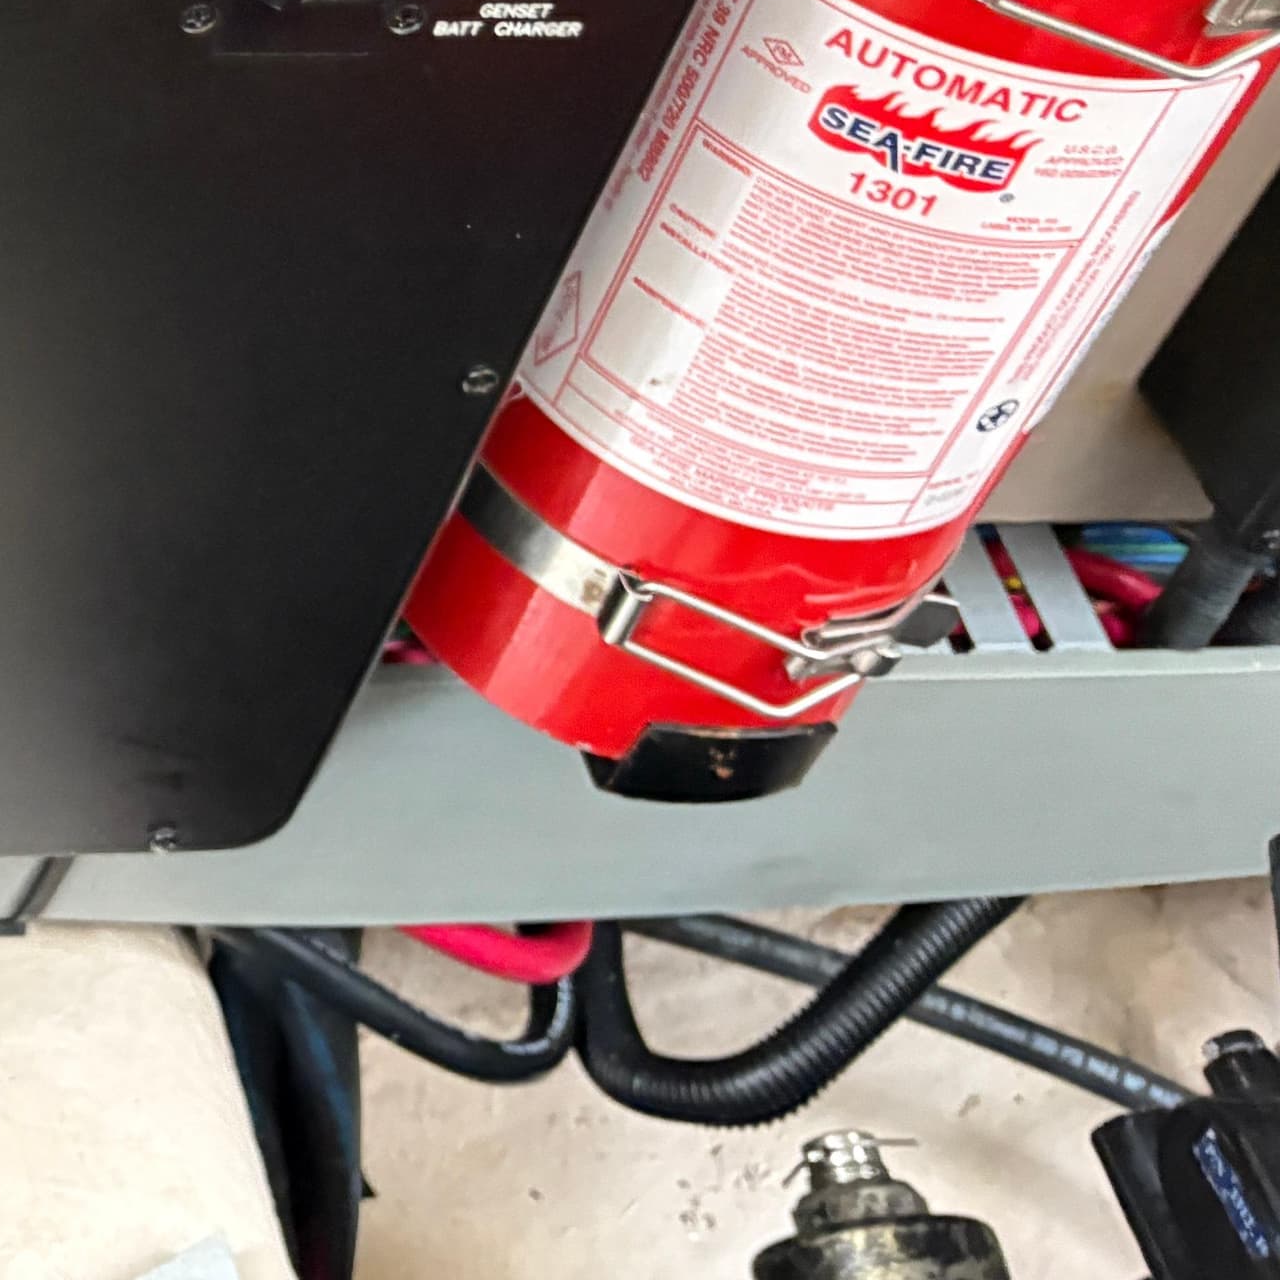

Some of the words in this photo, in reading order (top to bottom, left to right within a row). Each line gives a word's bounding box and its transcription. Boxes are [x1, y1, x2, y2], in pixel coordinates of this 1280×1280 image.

[433, 21, 484, 36] BATT
[494, 18, 583, 37] CHARGER
[479, 3, 554, 19] GENSET
[693, 25, 721, 67] NRC
[825, 28, 1088, 122] AUTOMATIC
[822, 107, 1010, 180] SEA-FIRE
[848, 172, 938, 216] 1301
